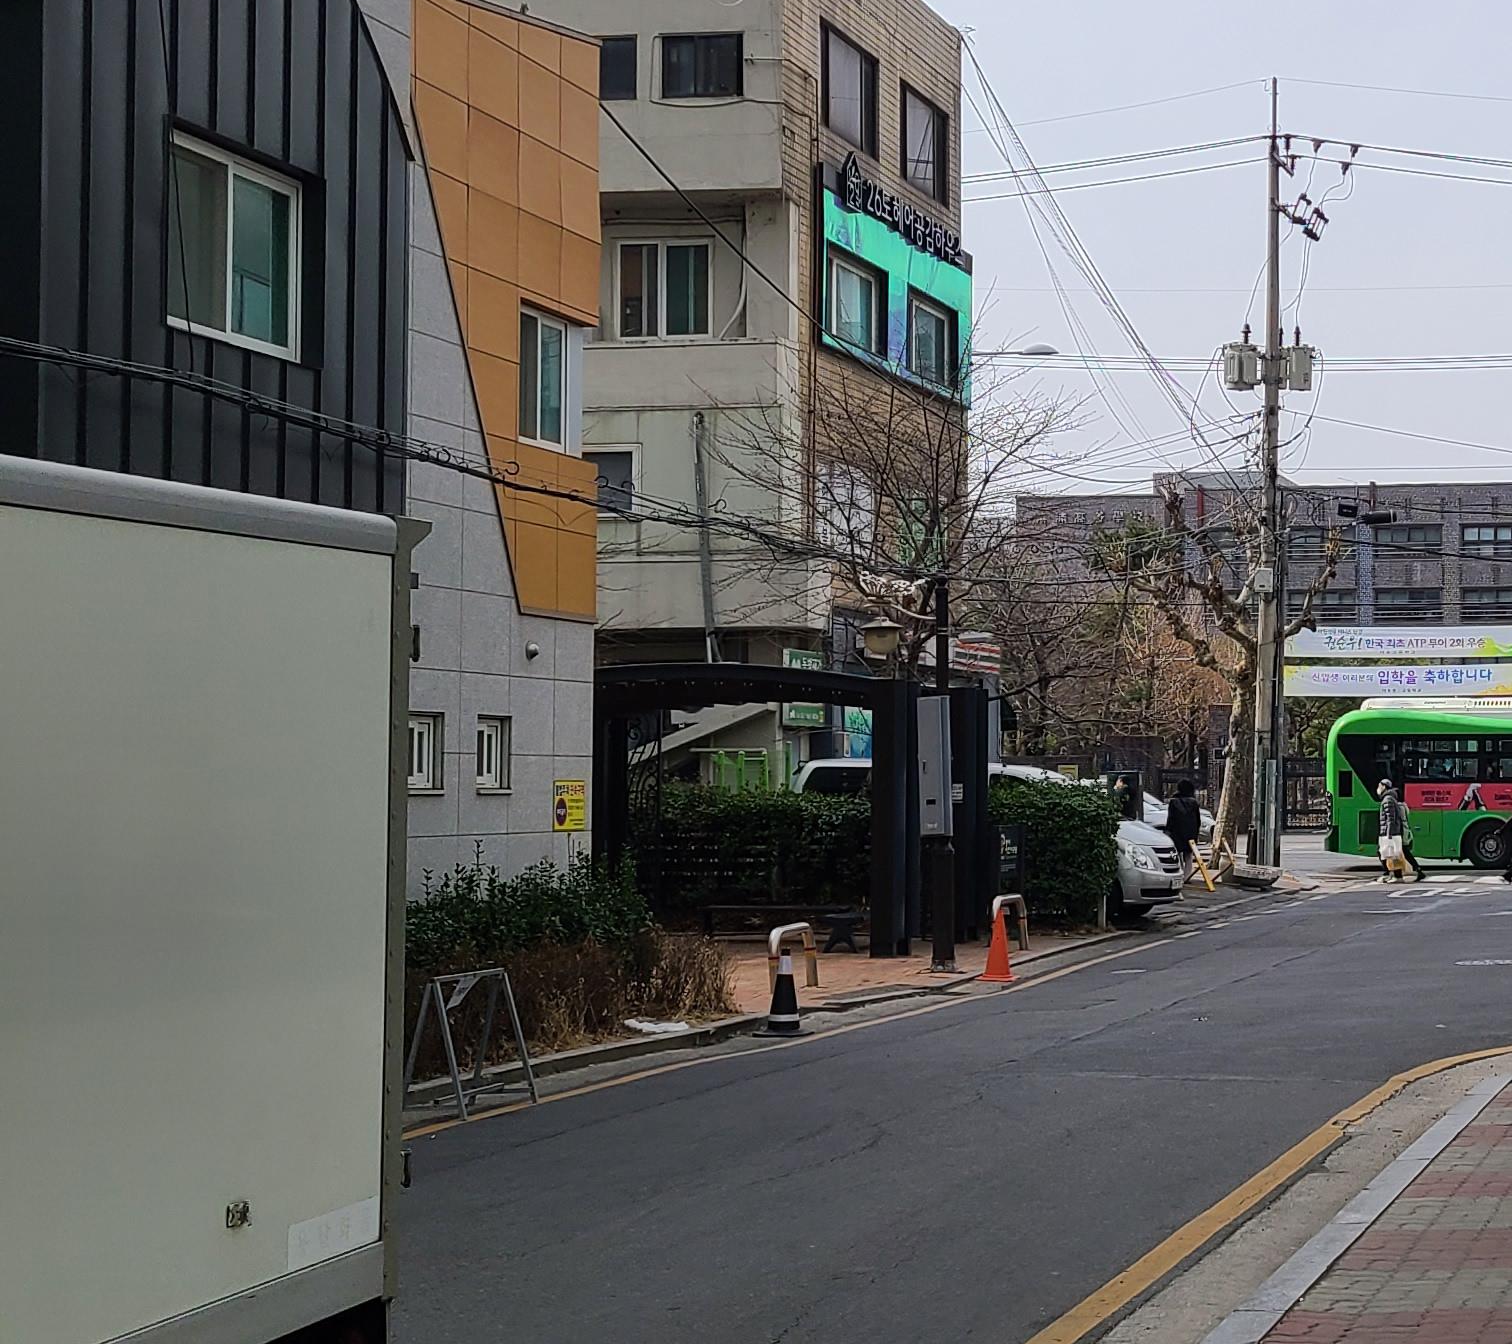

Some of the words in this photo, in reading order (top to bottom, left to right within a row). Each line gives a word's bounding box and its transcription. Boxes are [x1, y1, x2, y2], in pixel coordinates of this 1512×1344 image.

[1407, 637, 1427, 649] ATP
[1377, 669, 1418, 685] 입학을
[1423, 668, 1492, 685] 축하합니다
